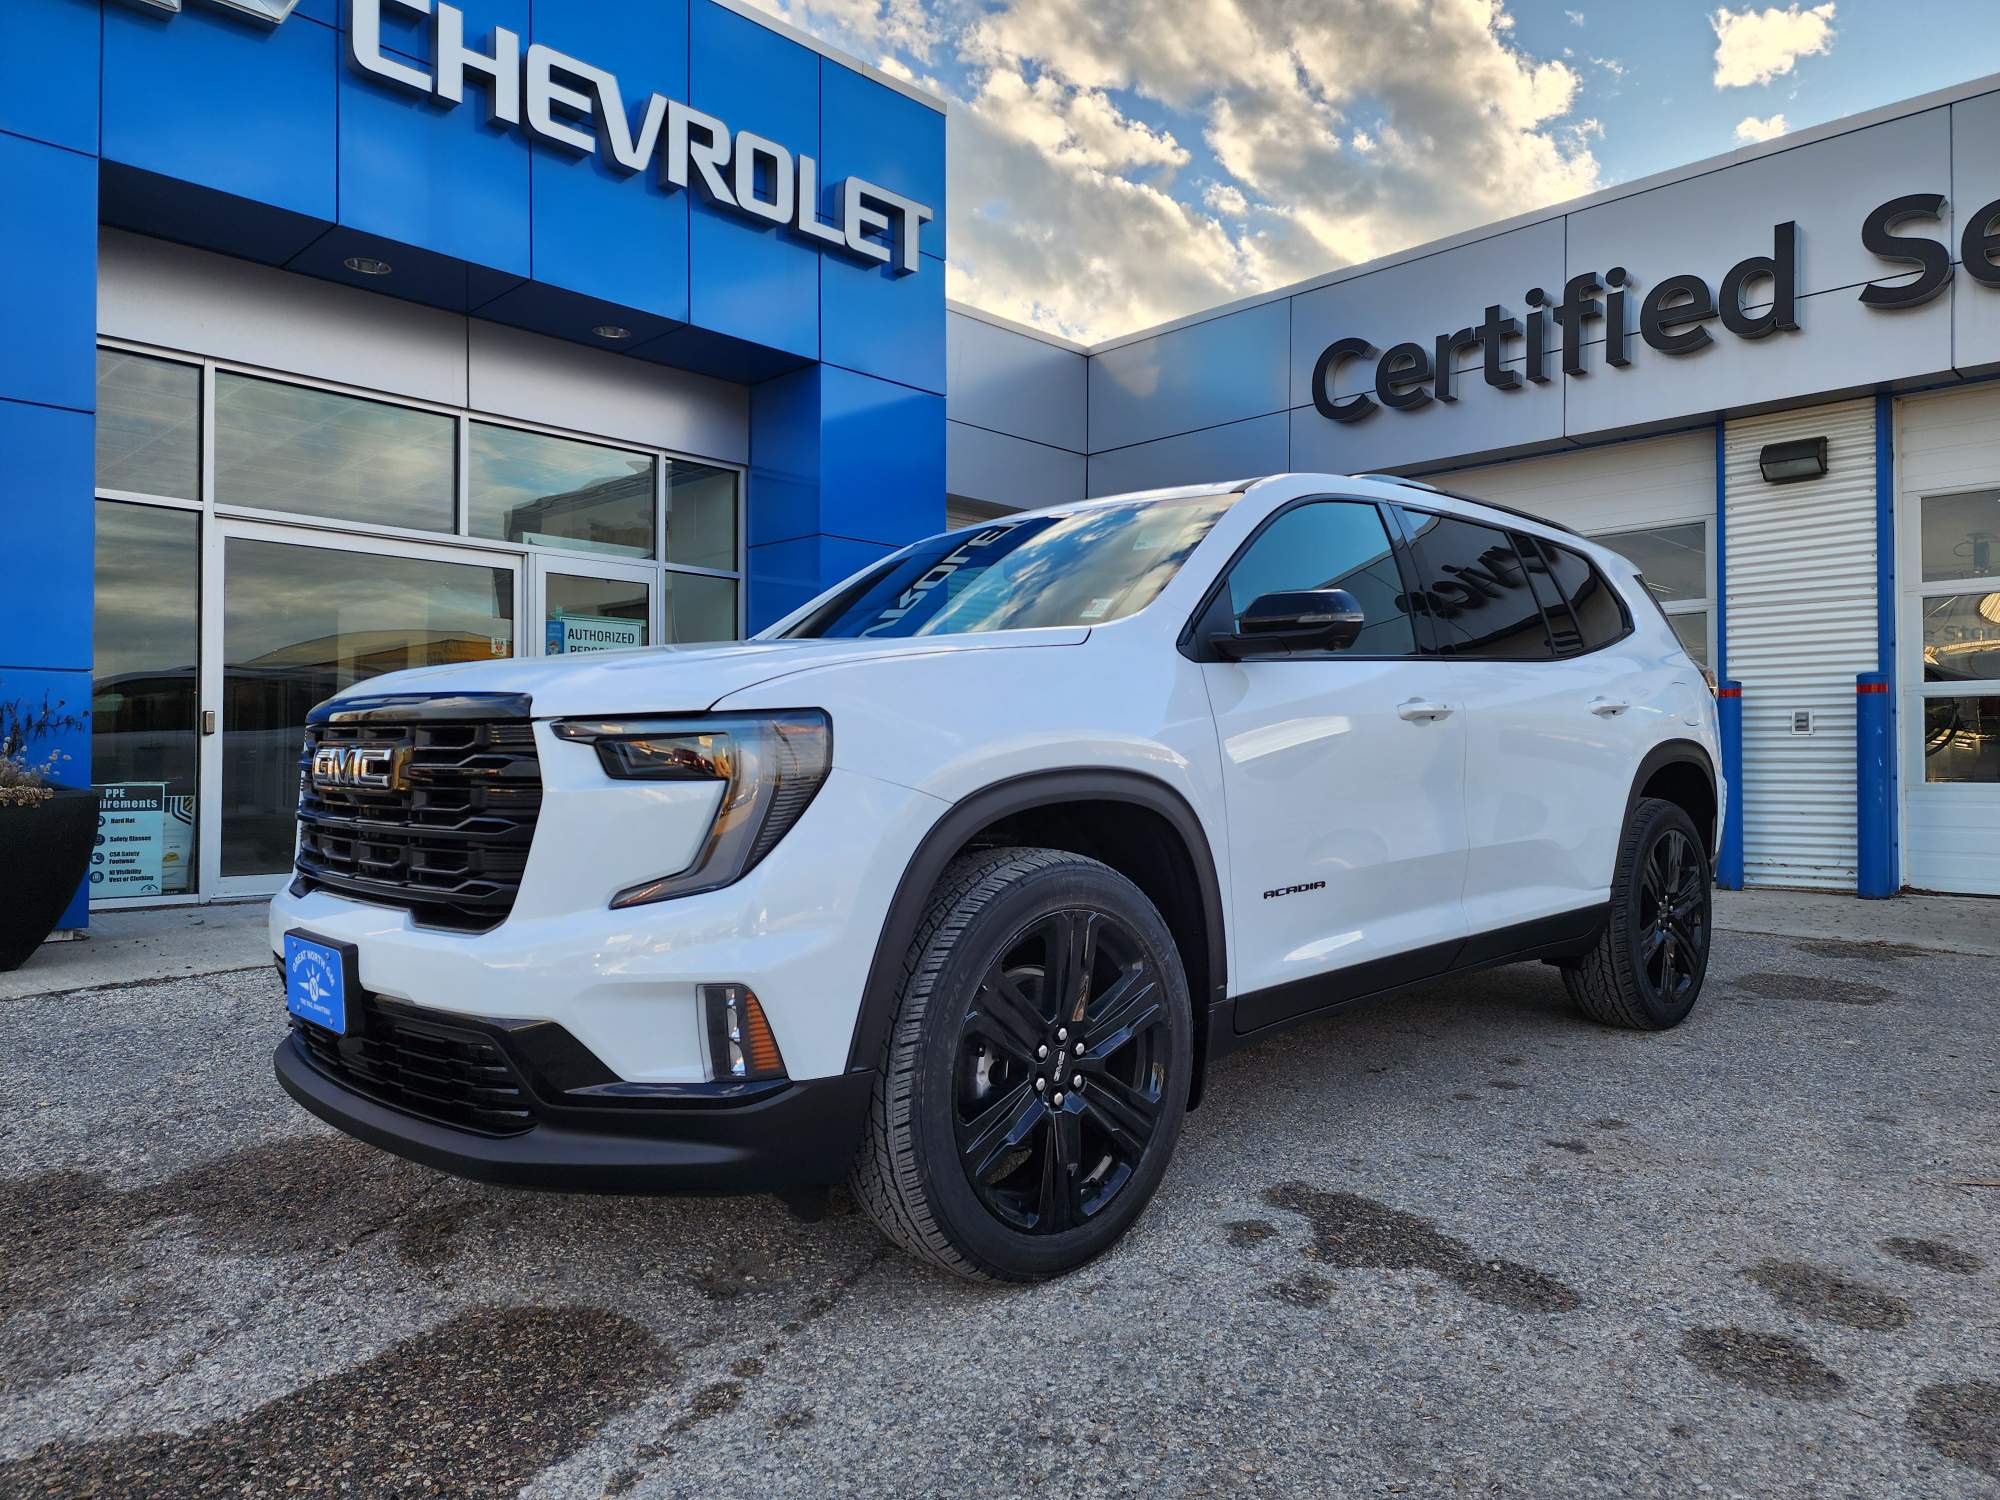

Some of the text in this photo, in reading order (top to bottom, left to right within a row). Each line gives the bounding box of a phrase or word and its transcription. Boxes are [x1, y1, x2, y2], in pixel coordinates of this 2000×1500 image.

[352, 0, 934, 276] CHEVROLET
[1311, 221, 1799, 422] Certified
[567, 628, 635, 644] AUTHORIZED
[313, 748, 393, 786] GMC
[105, 788, 126, 798] PPE
[100, 798, 158, 809] irements
[1263, 880, 1326, 899] ACADIA
